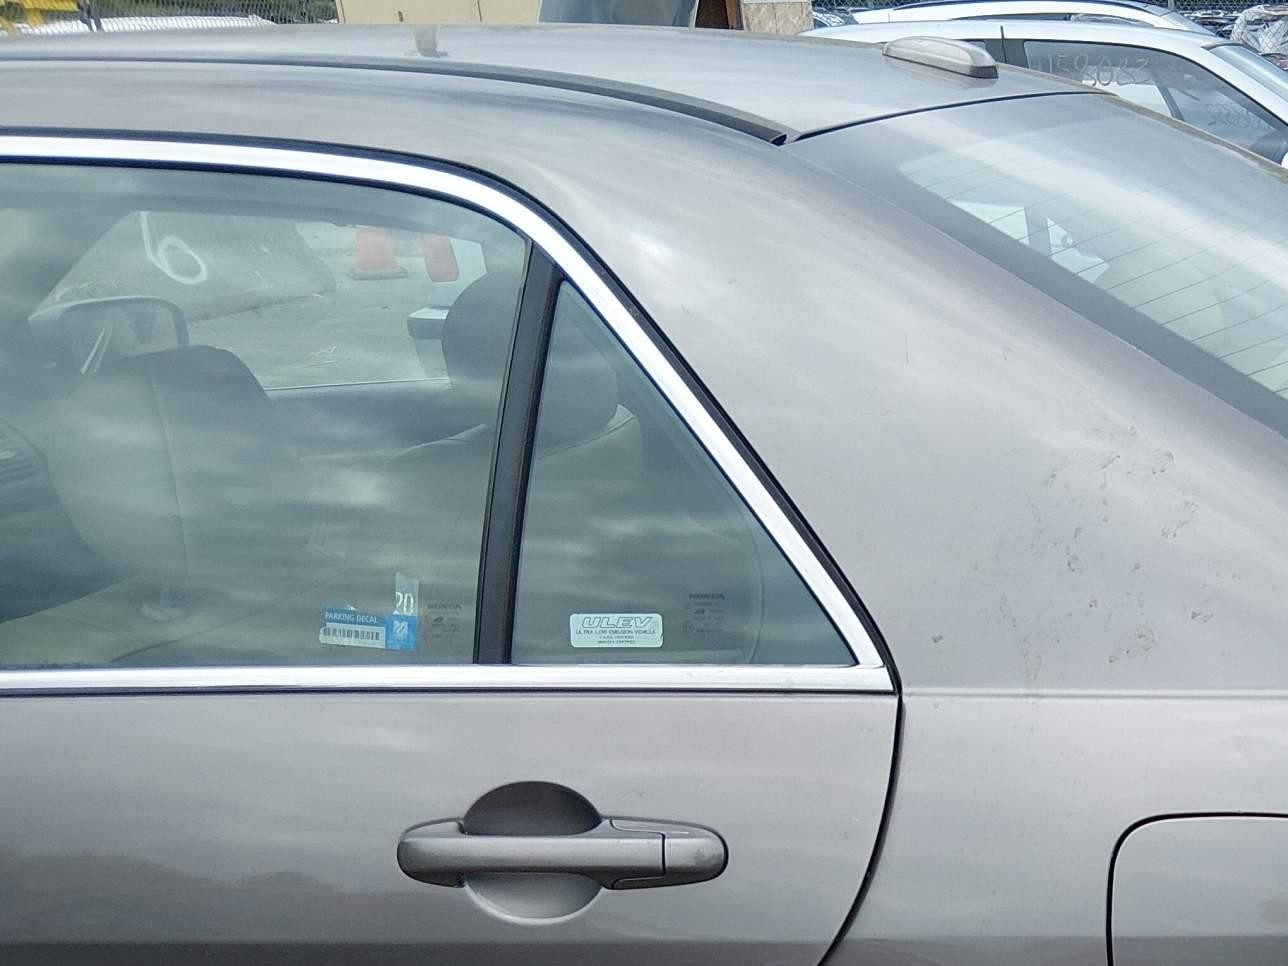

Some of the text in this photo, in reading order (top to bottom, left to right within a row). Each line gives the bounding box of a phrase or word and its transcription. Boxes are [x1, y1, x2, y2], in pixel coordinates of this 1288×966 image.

[325, 611, 378, 623] PARKING DECAL
[582, 616, 653, 629] ULEV
